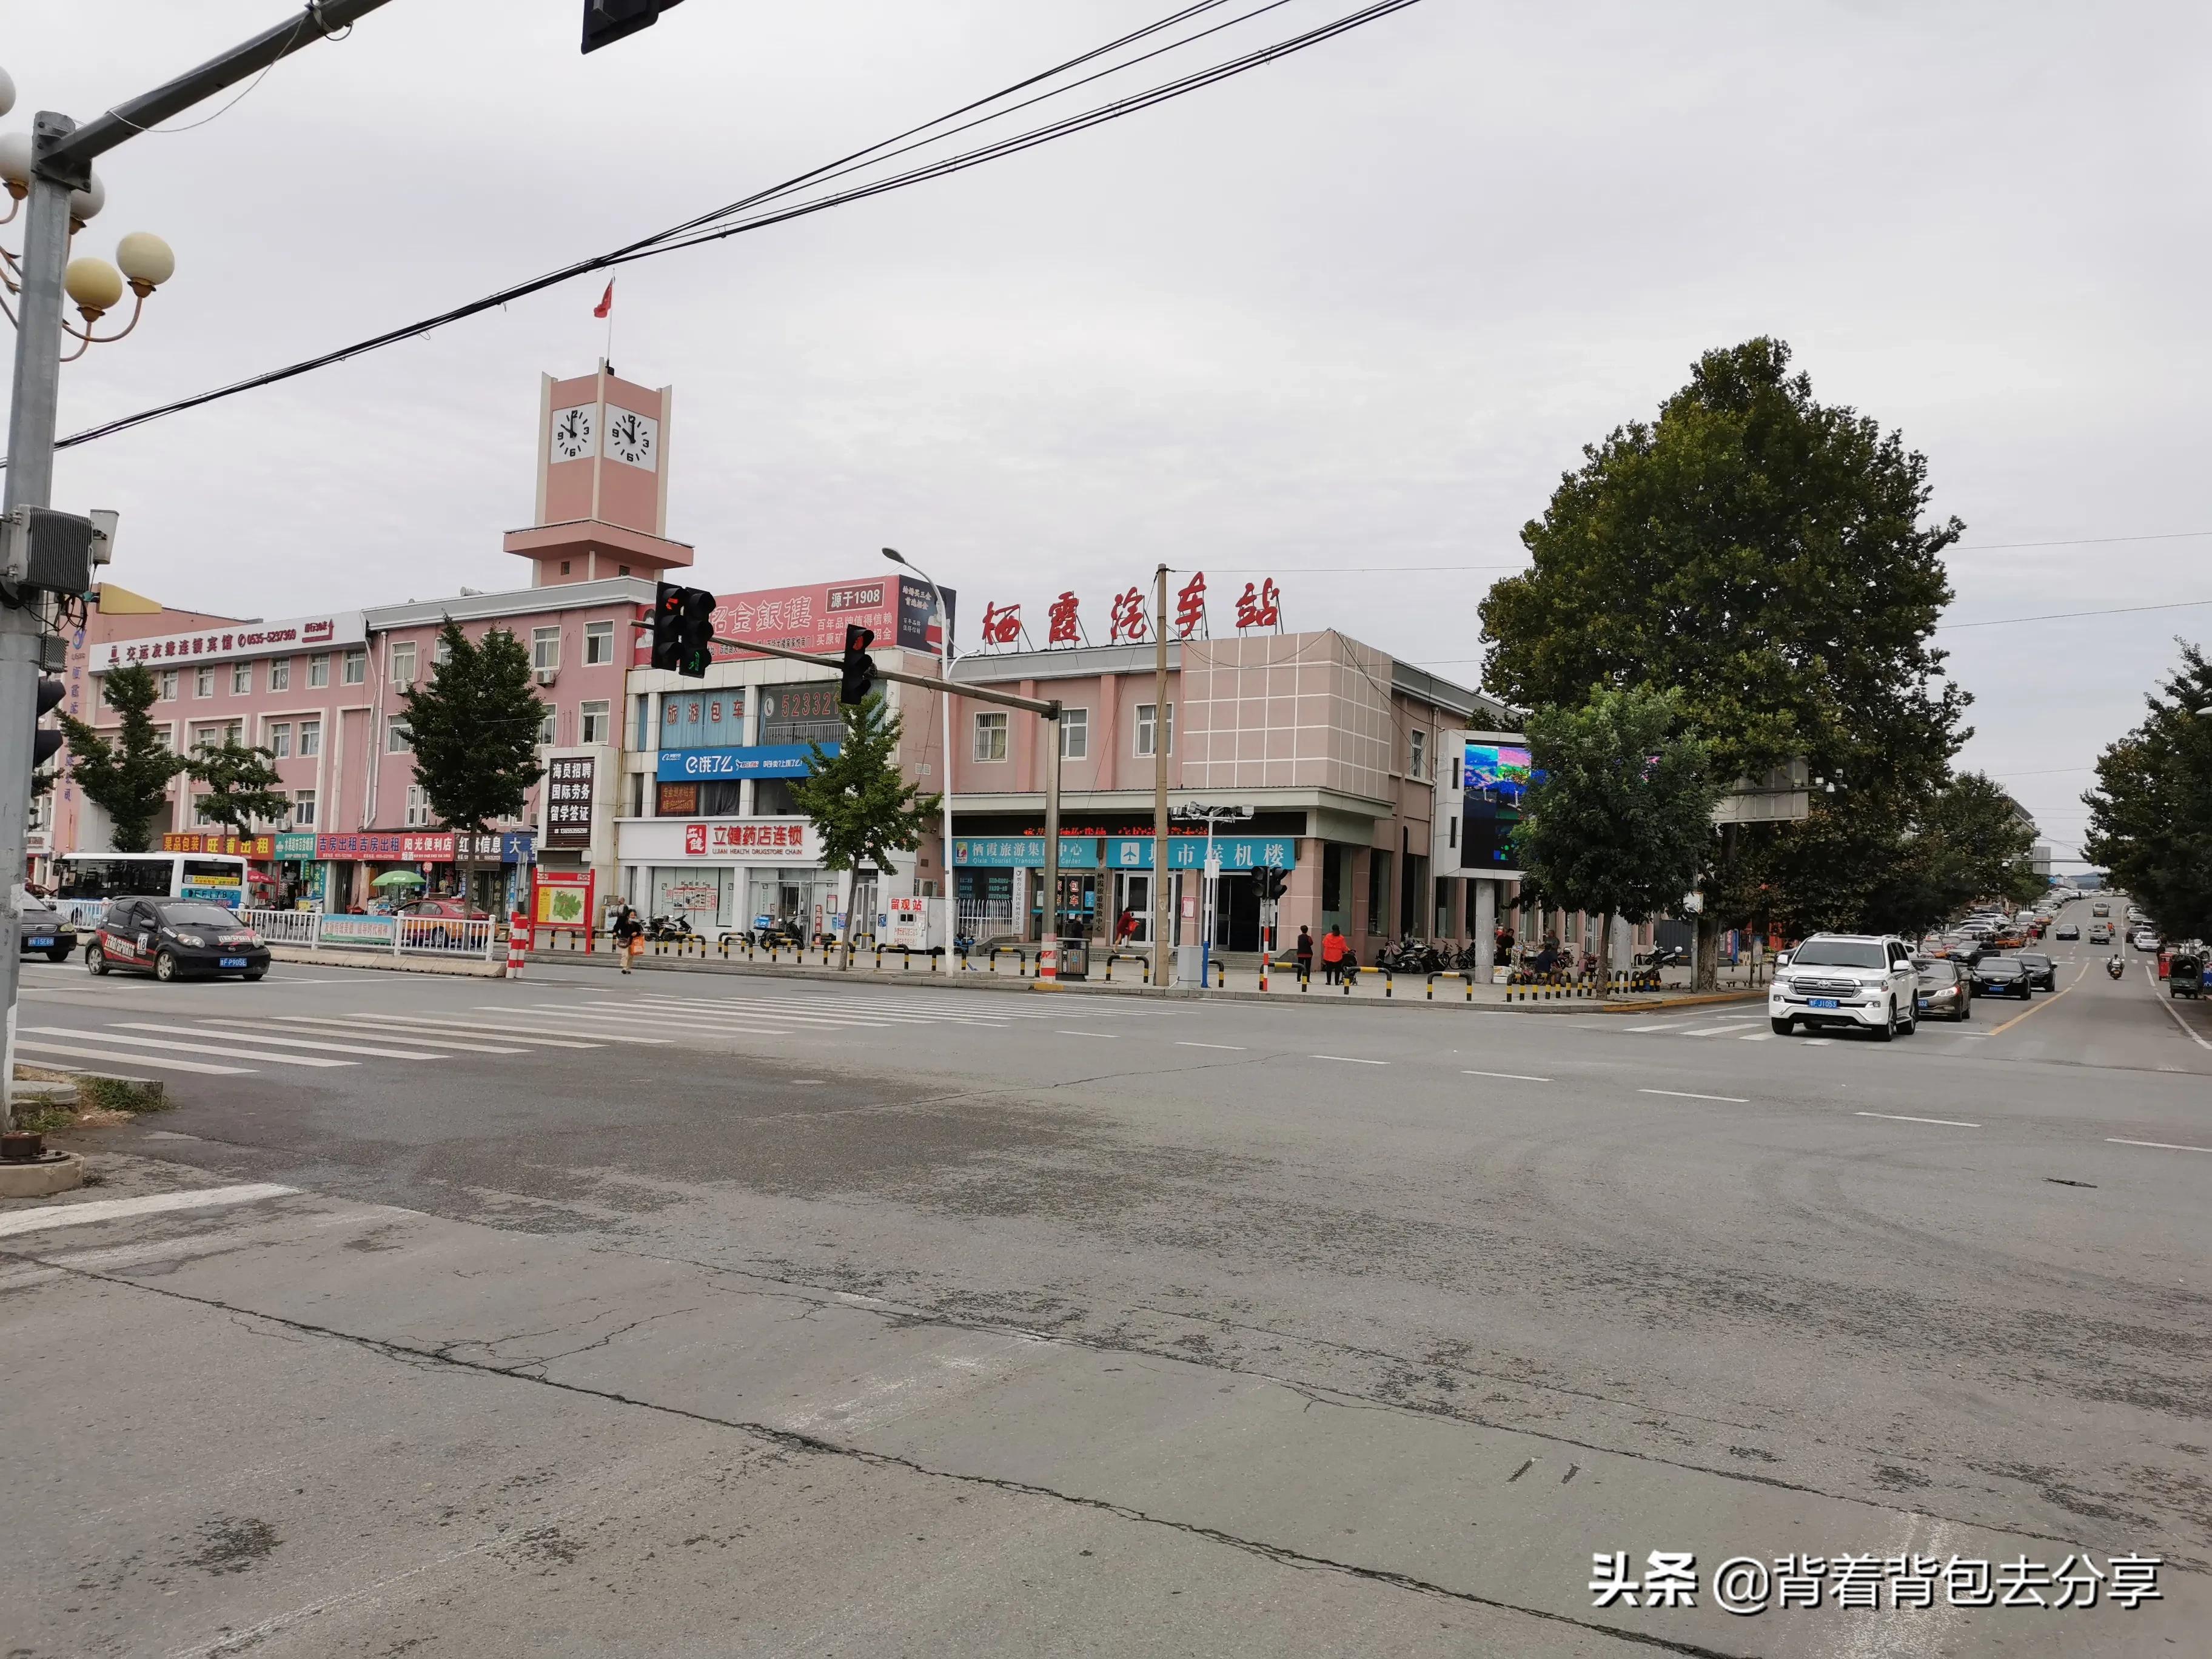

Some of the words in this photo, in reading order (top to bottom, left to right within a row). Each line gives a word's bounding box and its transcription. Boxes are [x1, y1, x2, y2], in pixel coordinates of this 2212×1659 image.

[831, 589, 880, 608] 源于1908
[982, 572, 1279, 645] 栖霞汽车站
[817, 612, 892, 631] 百年品牌值得信赖
[667, 699, 744, 724] 旅游包车
[553, 763, 591, 779] 海员招聘
[552, 784, 590, 800] 国际劳务
[551, 805, 589, 822] 留学签证
[164, 836, 199, 851] 果品包装
[320, 836, 357, 851] 吉房出租
[360, 836, 400, 851] 吉房出租
[712, 825, 803, 846] 立健药店连锁
[404, 837, 453, 851] 阳光便利店
[973, 842, 1082, 857] 栖霞旅游集中心
[891, 899, 922, 911] 留观站
[139, 939, 146, 949] 18
